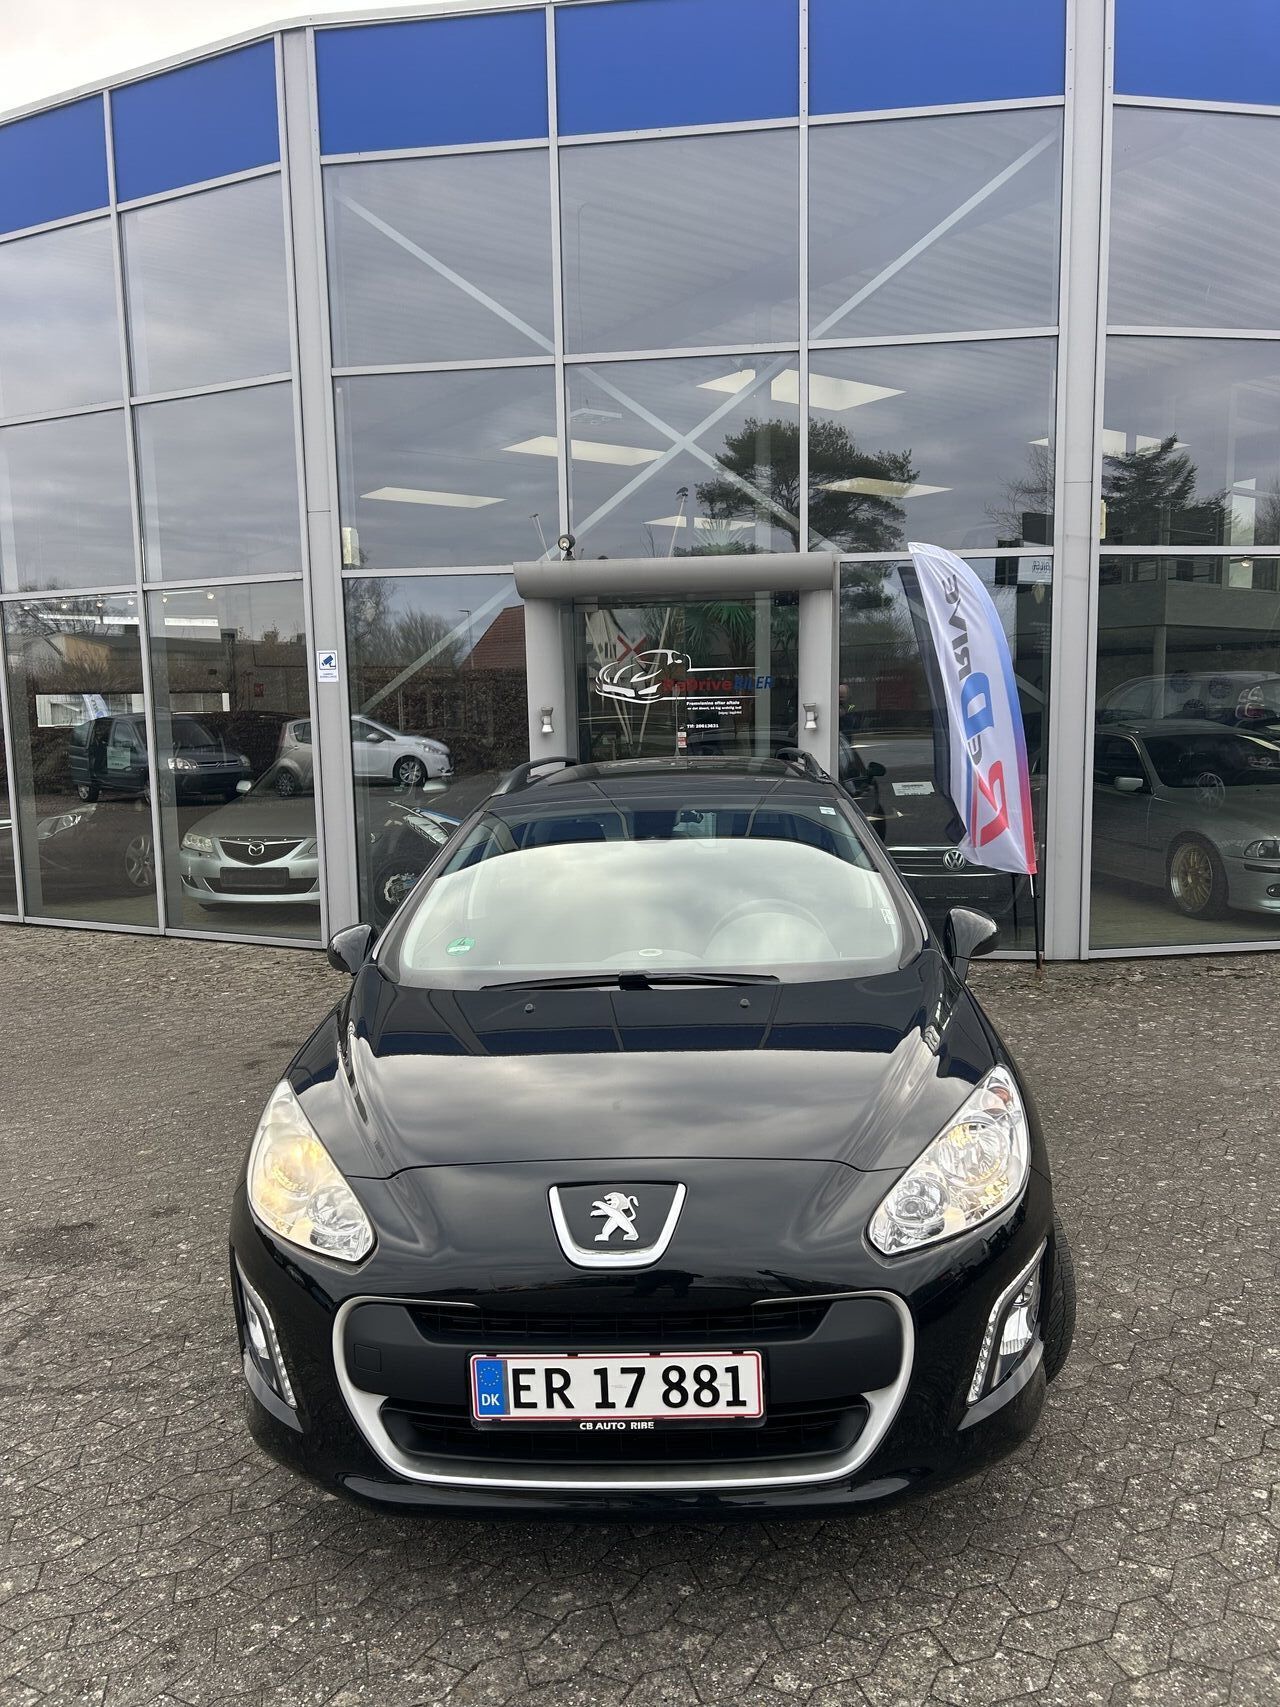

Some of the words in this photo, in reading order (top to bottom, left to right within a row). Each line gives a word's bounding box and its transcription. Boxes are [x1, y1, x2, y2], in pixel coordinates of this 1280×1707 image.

[511, 1367, 574, 1409] ER
[593, 1366, 646, 1409] 17
[661, 1364, 747, 1409] 881
[481, 1393, 500, 1407] DK
[579, 1422, 593, 1430] CB
[595, 1422, 626, 1430] AUTO
[630, 1421, 654, 1430] RIBE
